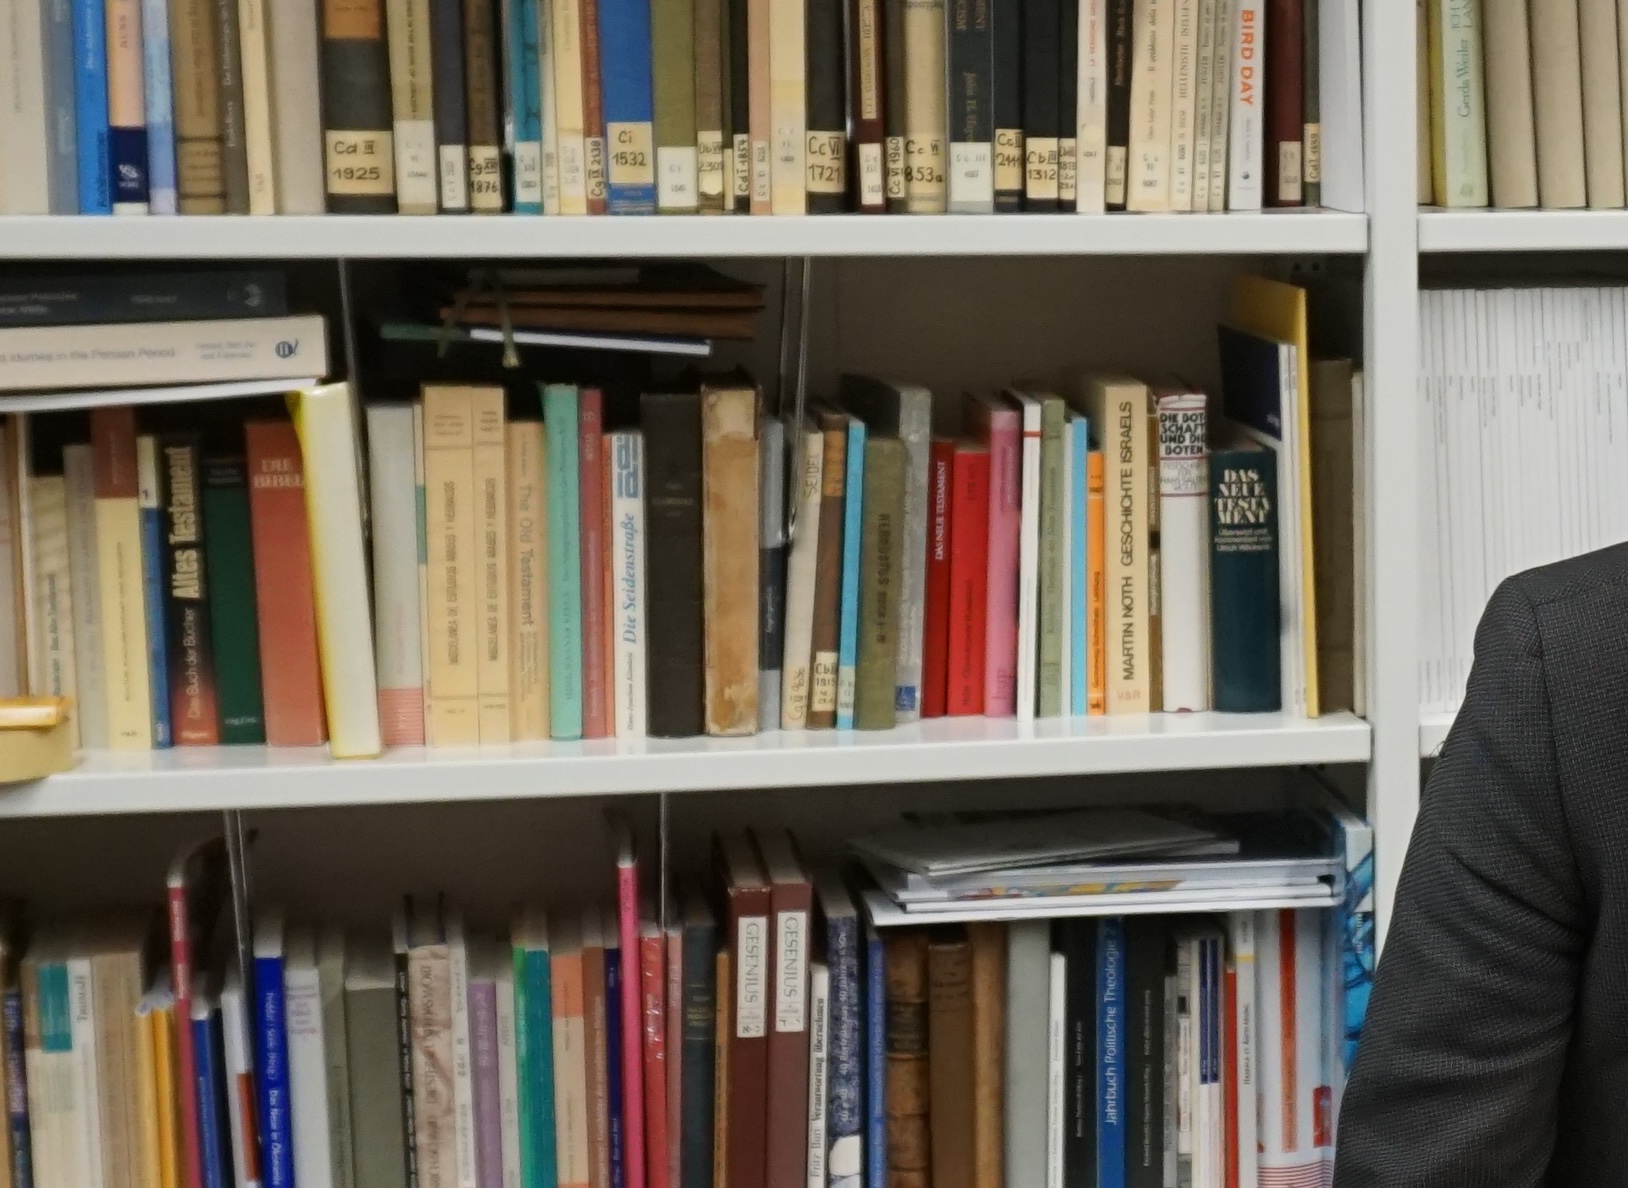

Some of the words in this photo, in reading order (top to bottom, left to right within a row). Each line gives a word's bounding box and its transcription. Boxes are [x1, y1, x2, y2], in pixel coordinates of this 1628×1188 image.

[1239, 9, 1255, 60] BIRD
[1456, 38, 1470, 78] Weiler
[1239, 65, 1256, 106] DAY
[1456, 78, 1471, 118] Gerda
[332, 166, 381, 181] 1925
[590, 140, 602, 167] 2138
[611, 152, 647, 167] 1532
[1027, 167, 1057, 181] 1312
[1118, 401, 1132, 464] ISRAELS
[1159, 412, 1180, 424] DIE
[1161, 423, 1206, 435] SCHAFT
[1164, 444, 1204, 456] BOTEN
[1219, 482, 1266, 498] NEUE
[1223, 468, 1259, 483] DAS
[164, 446, 197, 546] Testament
[518, 482, 533, 512] The
[519, 519, 534, 544] Old
[934, 515, 946, 541] NEUE
[1119, 468, 1134, 567] GESCHICHTE
[170, 548, 201, 599] Altes
[618, 512, 638, 613] Seidenstraße
[519, 548, 535, 627] Testament
[1120, 576, 1134, 618] NOTH
[182, 607, 197, 647] Bücher
[621, 616, 638, 645] Die
[183, 648, 198, 666] der
[1120, 622, 1135, 681] MARTIN
[185, 667, 199, 696] Buch
[187, 695, 202, 719] Das
[743, 922, 760, 1004] GESENIUS
[782, 916, 800, 998] GESENIUS
[1103, 939, 1120, 1003] Theologie
[810, 997, 824, 1054] übernehmen
[1103, 1006, 1117, 1064] Politische
[810, 1056, 825, 1122] Verantwortung
[1104, 1067, 1118, 1126] Jahrbuch
